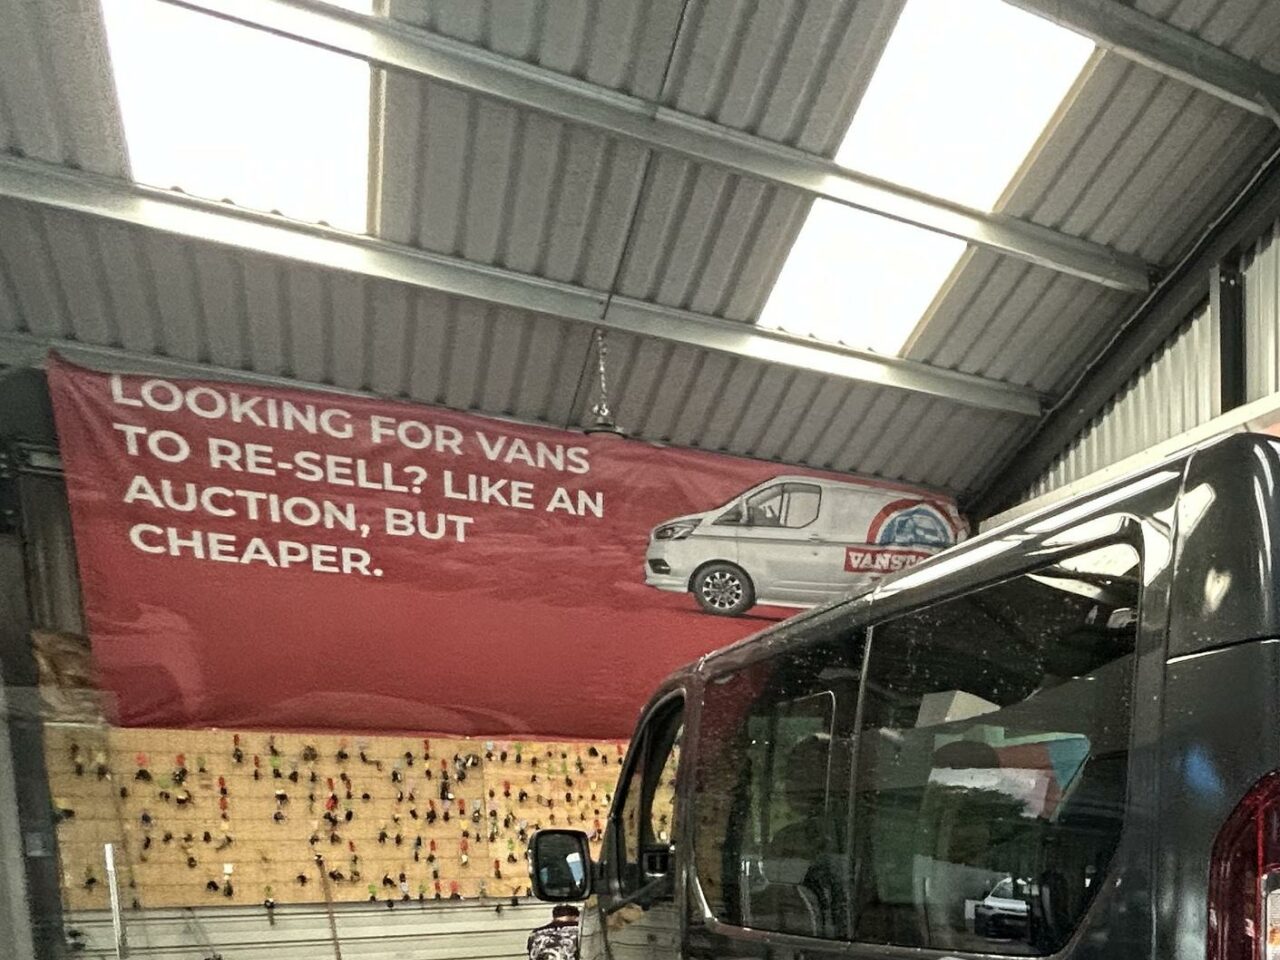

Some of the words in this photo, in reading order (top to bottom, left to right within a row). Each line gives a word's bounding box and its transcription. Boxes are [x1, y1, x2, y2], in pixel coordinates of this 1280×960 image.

[111, 374, 354, 439] LOOKING
[371, 415, 464, 455] FOR
[476, 431, 590, 475] VANS
[112, 422, 190, 463] TO
[208, 437, 427, 495] RE-SELL?
[443, 470, 535, 510] LIKE
[546, 487, 604, 519] AN
[123, 475, 370, 539] AUCTION,
[384, 507, 474, 543] BUT
[129, 523, 384, 577] CHEAPER.
